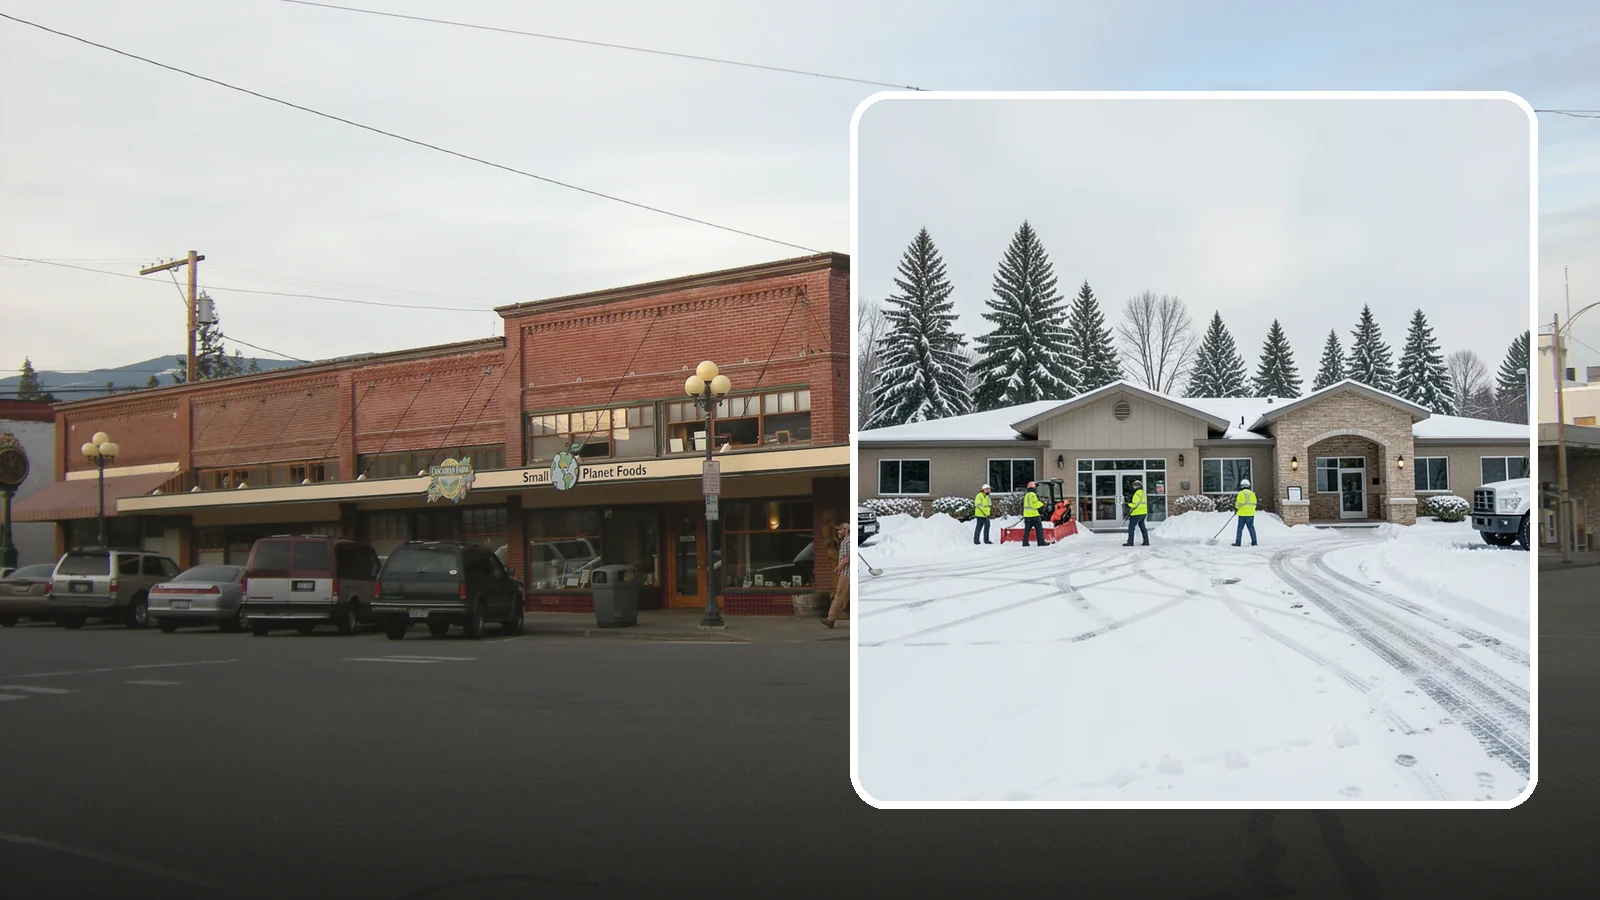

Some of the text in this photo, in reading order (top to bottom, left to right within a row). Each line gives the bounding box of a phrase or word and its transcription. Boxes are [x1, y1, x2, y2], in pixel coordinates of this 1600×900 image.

[431, 465, 469, 475] CASCADIAN FARM
[523, 464, 647, 483] Small Planet Foods
